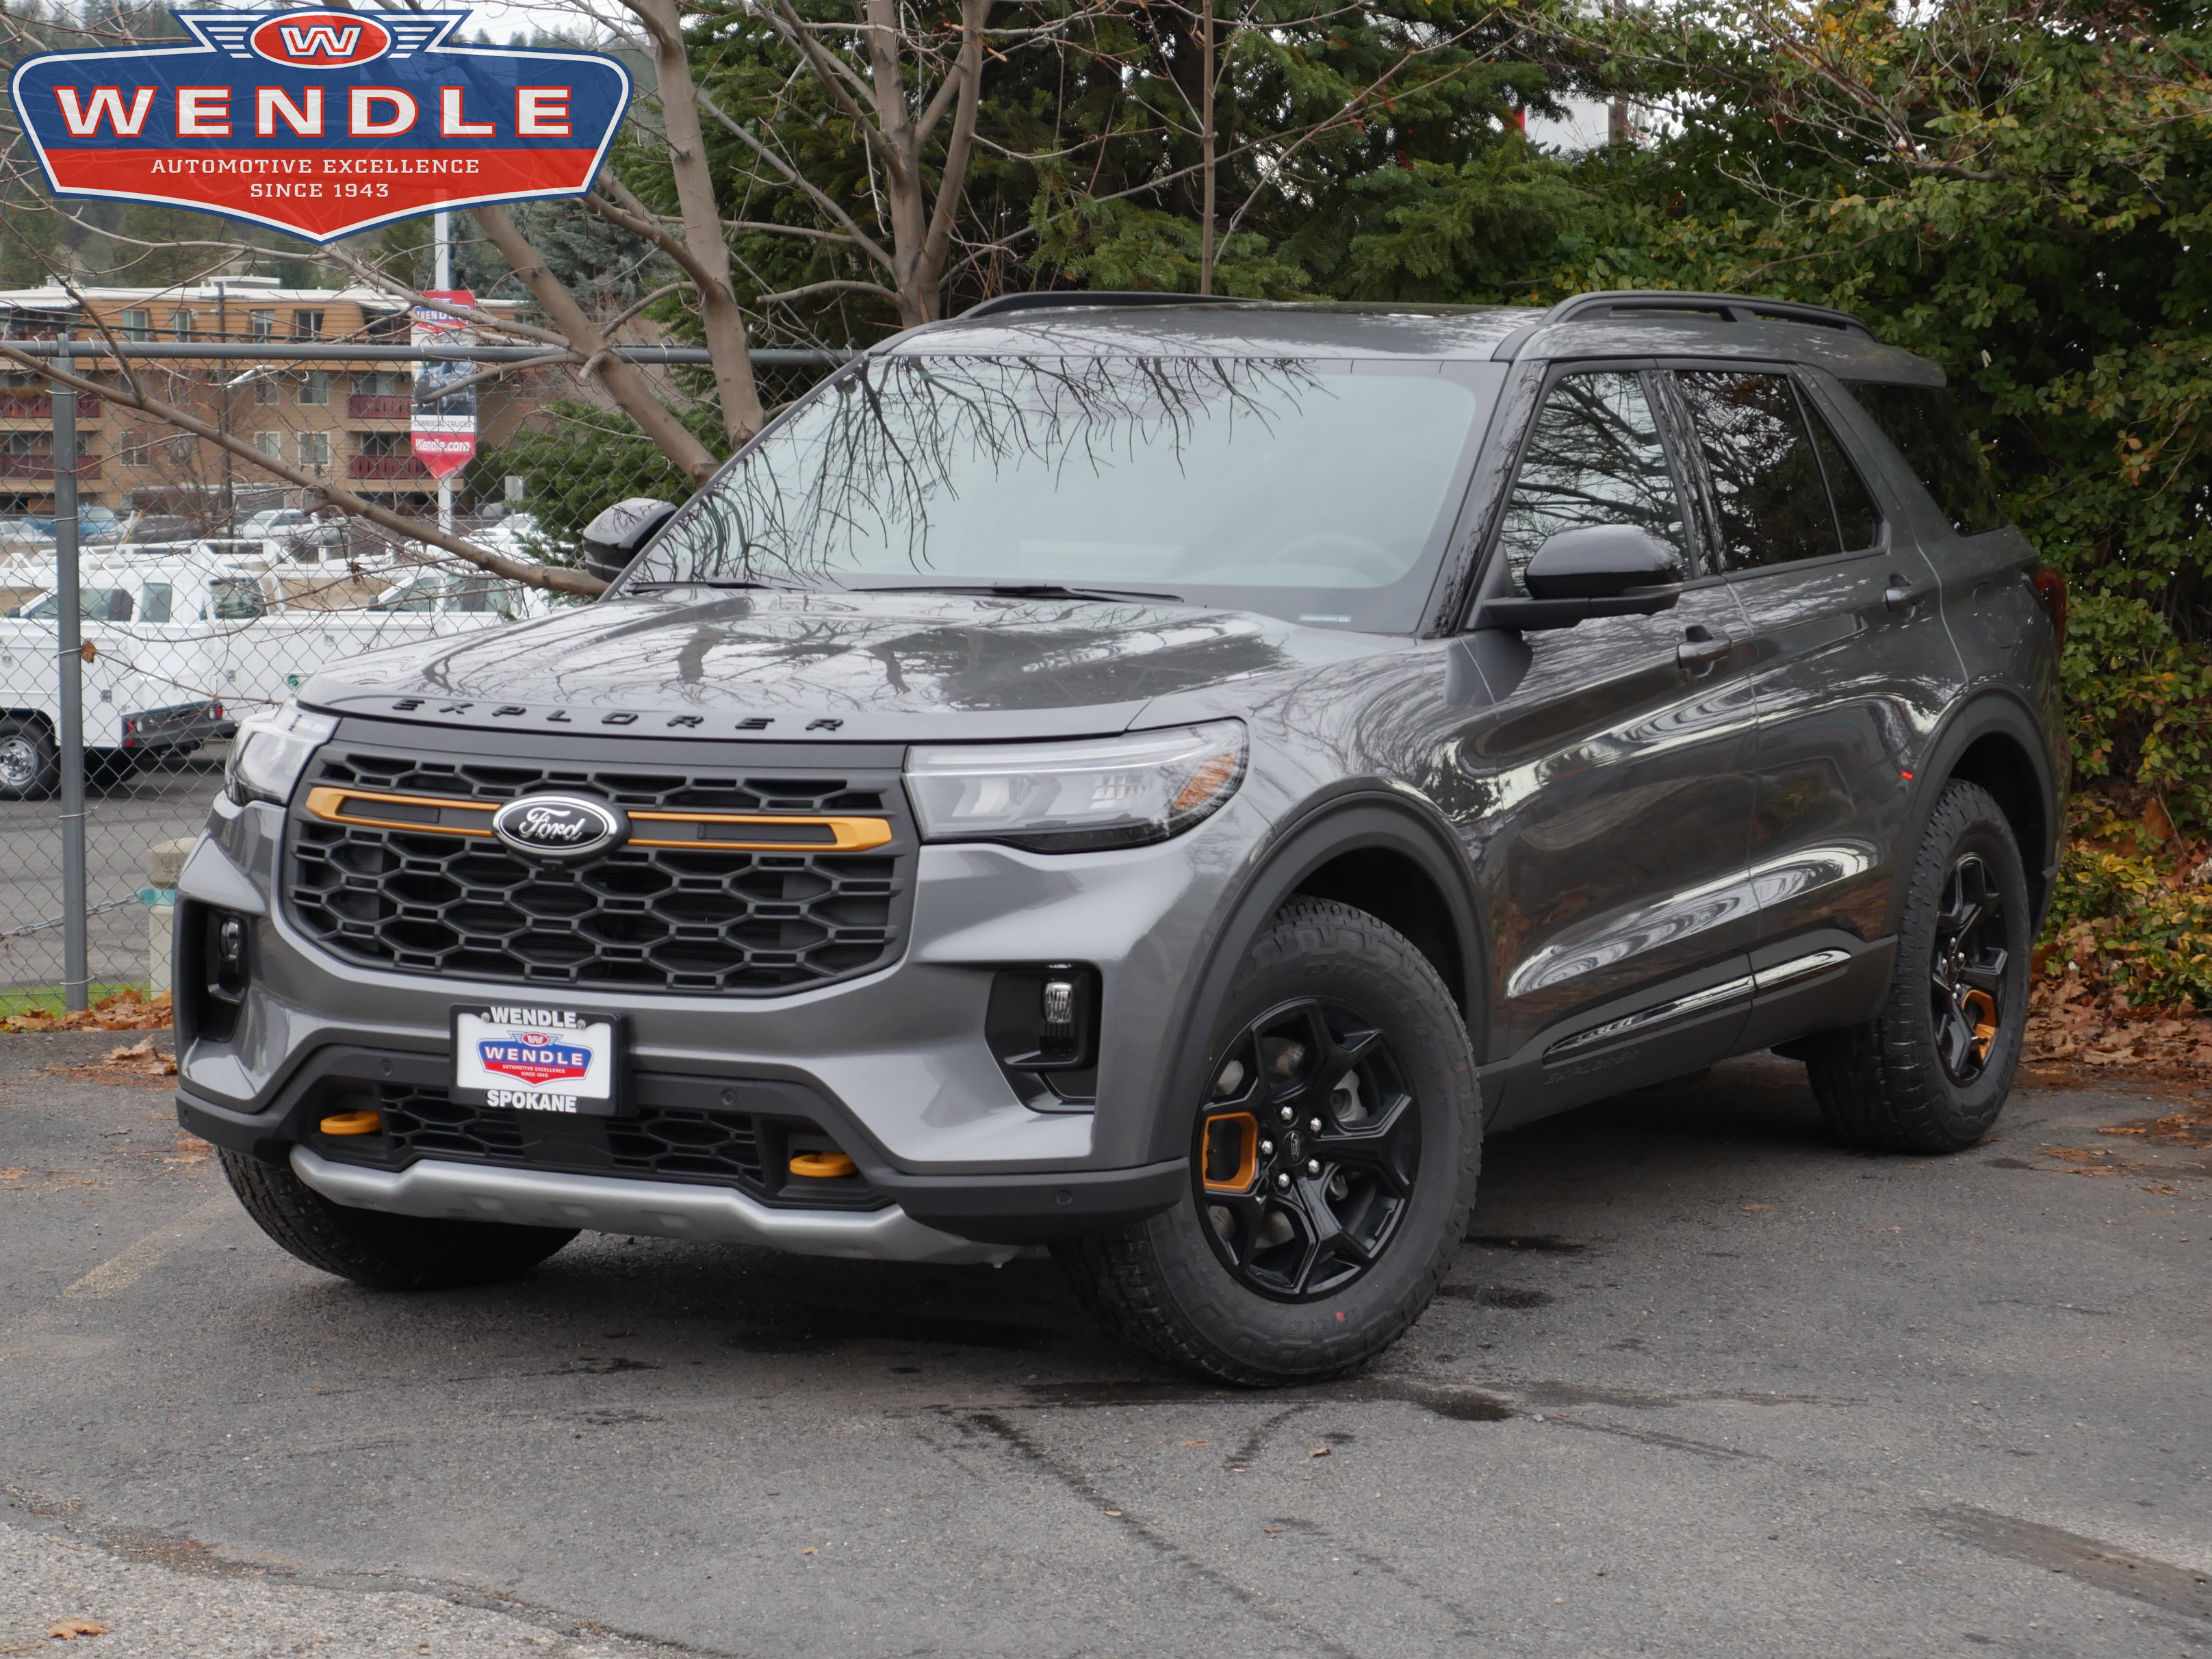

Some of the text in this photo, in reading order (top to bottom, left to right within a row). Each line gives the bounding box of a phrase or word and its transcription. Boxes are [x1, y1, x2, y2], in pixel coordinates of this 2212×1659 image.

[415, 438, 470, 452] Wendle.com
[391, 699, 844, 731] EXPLORER
[518, 807, 587, 842] Ford
[490, 1007, 577, 1028] WENDLE
[485, 1046, 583, 1066] WENDLE
[487, 1089, 577, 1113] SPOKANE
